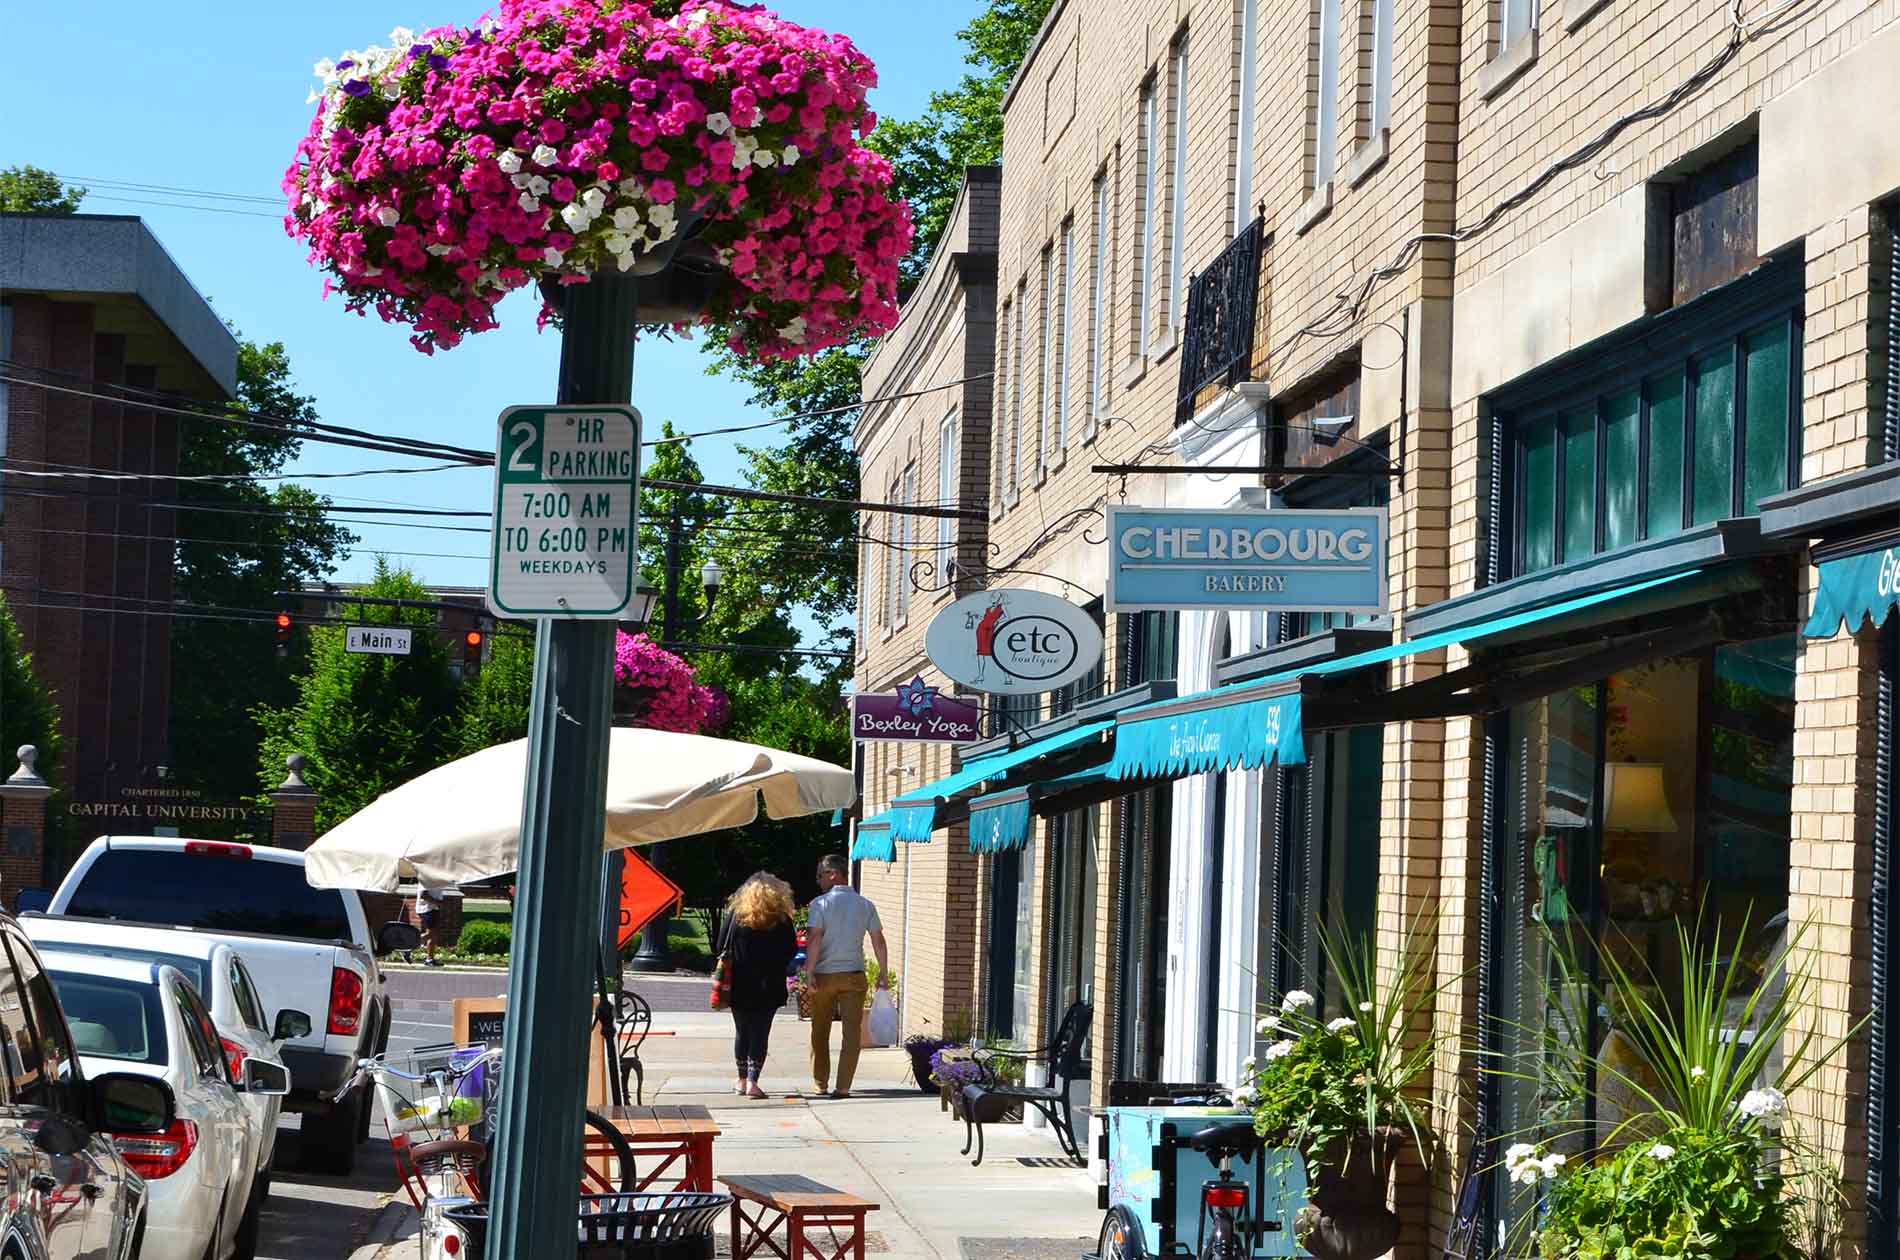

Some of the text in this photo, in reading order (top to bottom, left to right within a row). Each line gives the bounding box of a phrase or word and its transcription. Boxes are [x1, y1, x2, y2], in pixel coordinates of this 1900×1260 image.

[507, 418, 605, 472] 2 HR
[549, 451, 631, 477] PARKING
[523, 493, 610, 518] 7:00 AM
[505, 527, 625, 552] TO 6:00 PM
[1120, 527, 1373, 561] CHERBOURG
[520, 560, 607, 574] WEEKDAYS
[1205, 575, 1288, 593] BAKERY
[350, 632, 407, 649] E Main St
[1007, 626, 1061, 653] etc
[1011, 651, 1058, 668] boutique
[859, 713, 974, 738] Bexley Yoga
[121, 787, 179, 798] CHARTERED
[69, 803, 250, 820] CAPITAL UNIVERSITY
